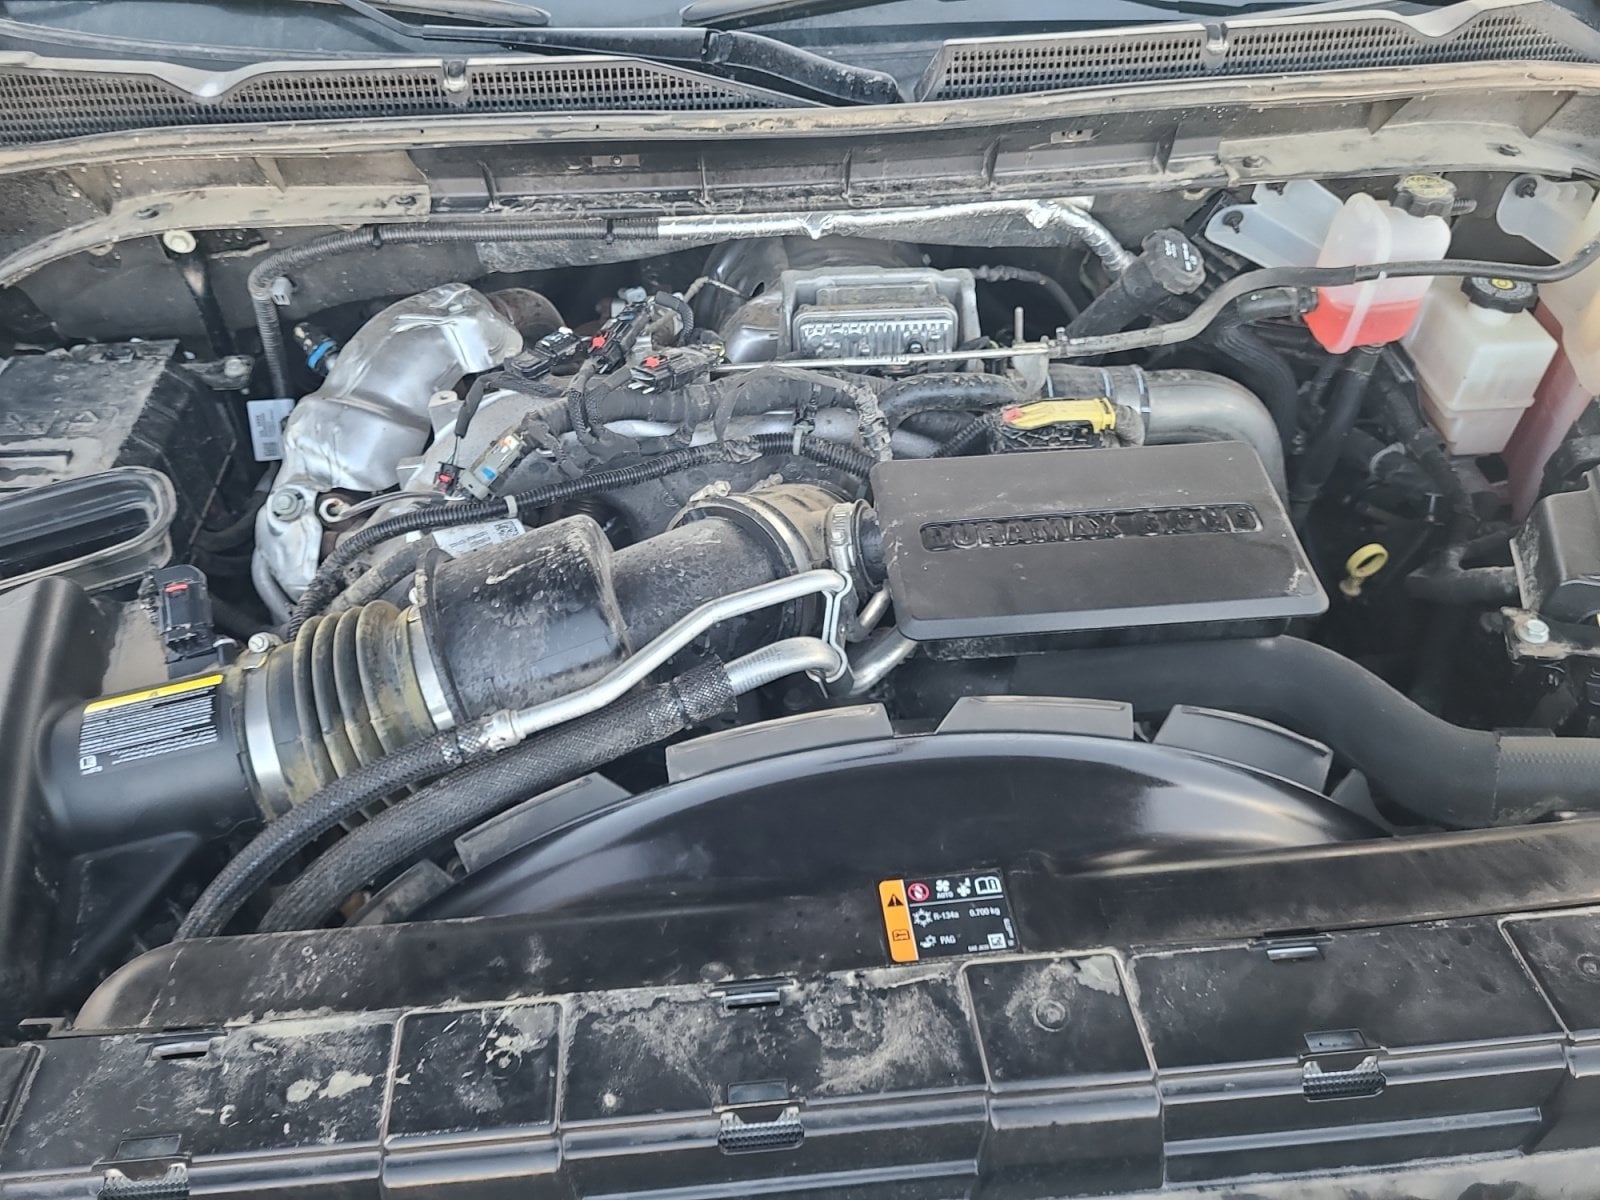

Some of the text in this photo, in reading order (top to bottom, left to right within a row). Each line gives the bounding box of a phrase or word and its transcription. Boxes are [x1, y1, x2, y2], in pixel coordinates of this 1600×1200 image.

[920, 513, 1124, 551] DURAMAX
[933, 910, 960, 921] R-134a
[990, 907, 1001, 916] kg
[940, 935, 957, 945] PAG
